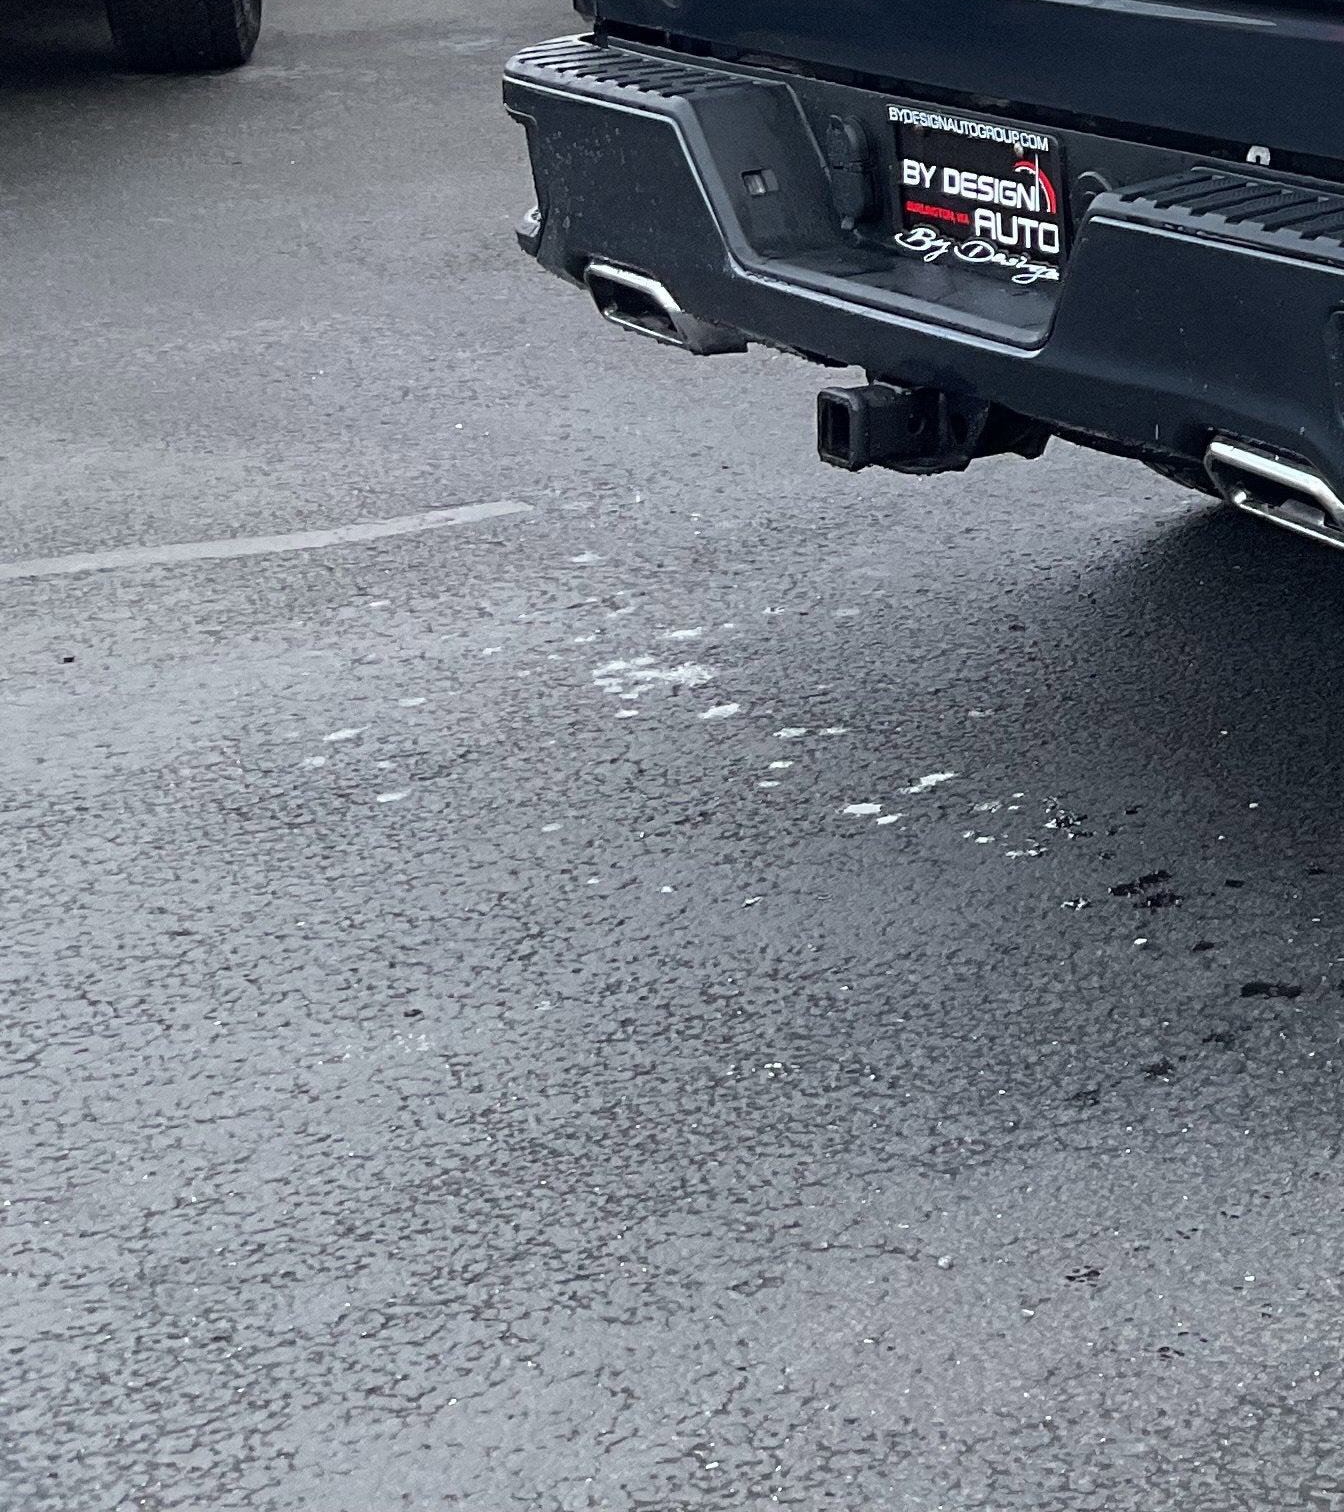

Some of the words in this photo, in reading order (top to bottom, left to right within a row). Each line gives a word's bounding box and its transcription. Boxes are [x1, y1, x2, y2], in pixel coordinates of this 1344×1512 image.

[903, 159, 937, 188] BY
[943, 167, 1036, 213] DESIGN
[894, 226, 951, 262] By
[974, 208, 1060, 254] AUTO
